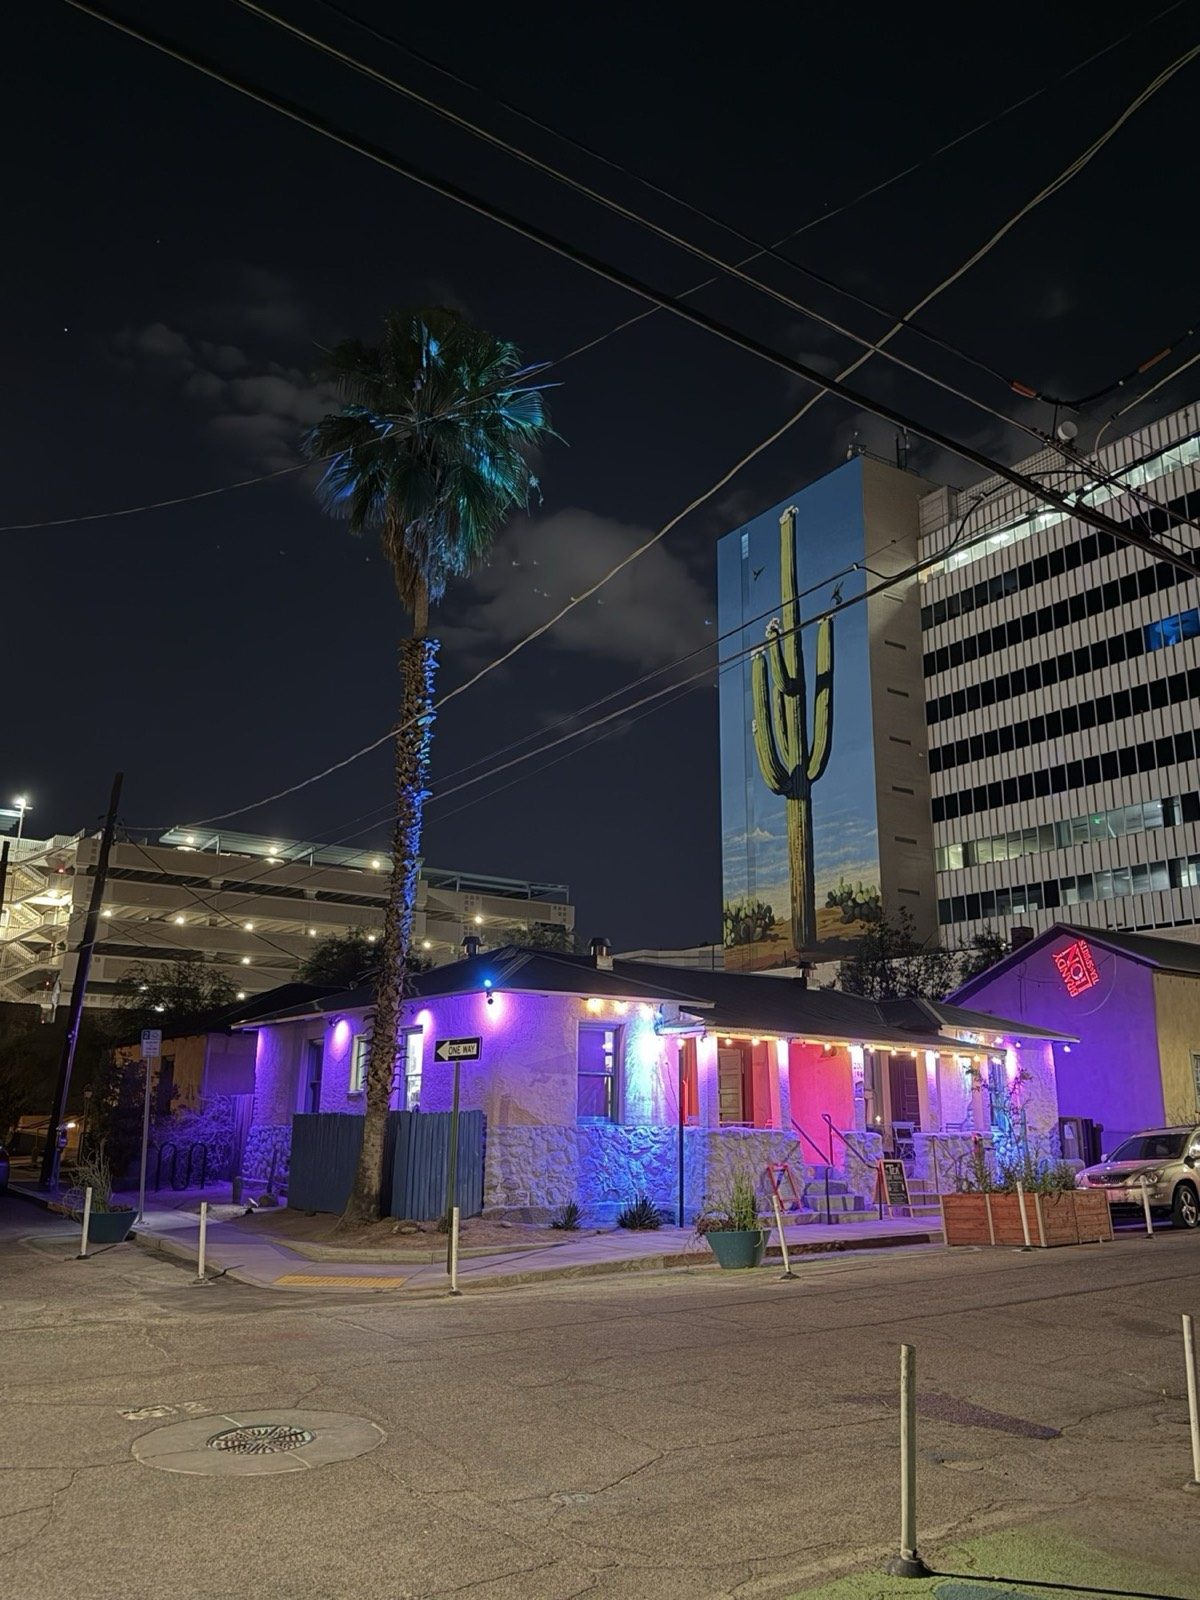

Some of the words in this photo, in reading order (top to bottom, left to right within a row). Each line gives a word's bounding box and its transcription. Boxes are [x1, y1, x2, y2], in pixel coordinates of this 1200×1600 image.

[1052, 954, 1078, 997] BRANDY
[1062, 944, 1092, 992] LION
[448, 1045, 460, 1055] ONE
[462, 1043, 475, 1053] WAY
